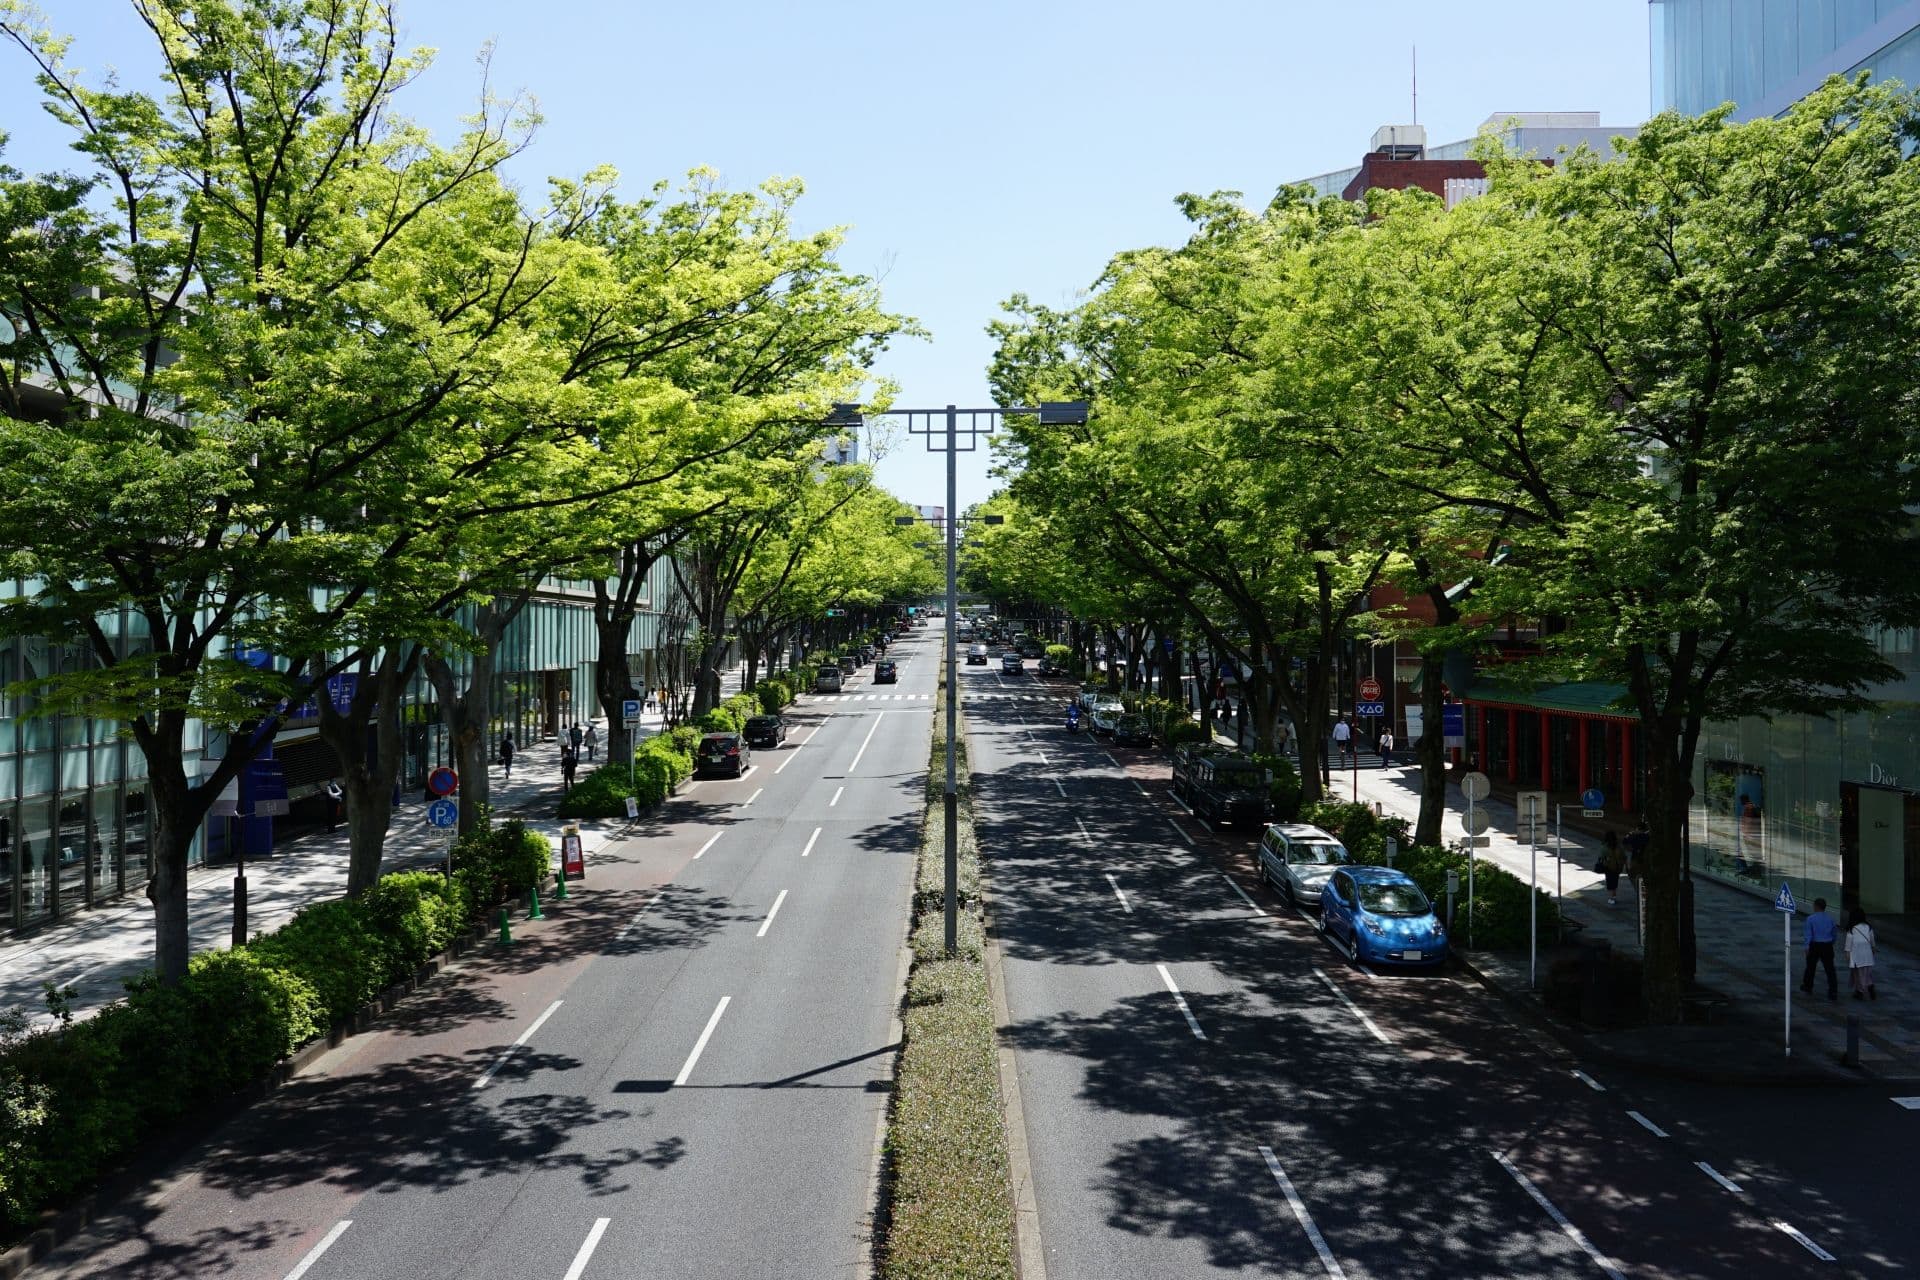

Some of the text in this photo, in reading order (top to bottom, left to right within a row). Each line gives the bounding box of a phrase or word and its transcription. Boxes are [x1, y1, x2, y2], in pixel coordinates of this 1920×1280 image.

[624, 701, 639, 717] P
[1869, 762, 1899, 787] Dior
[435, 807, 447, 825] P
[443, 815, 452, 825] 60
